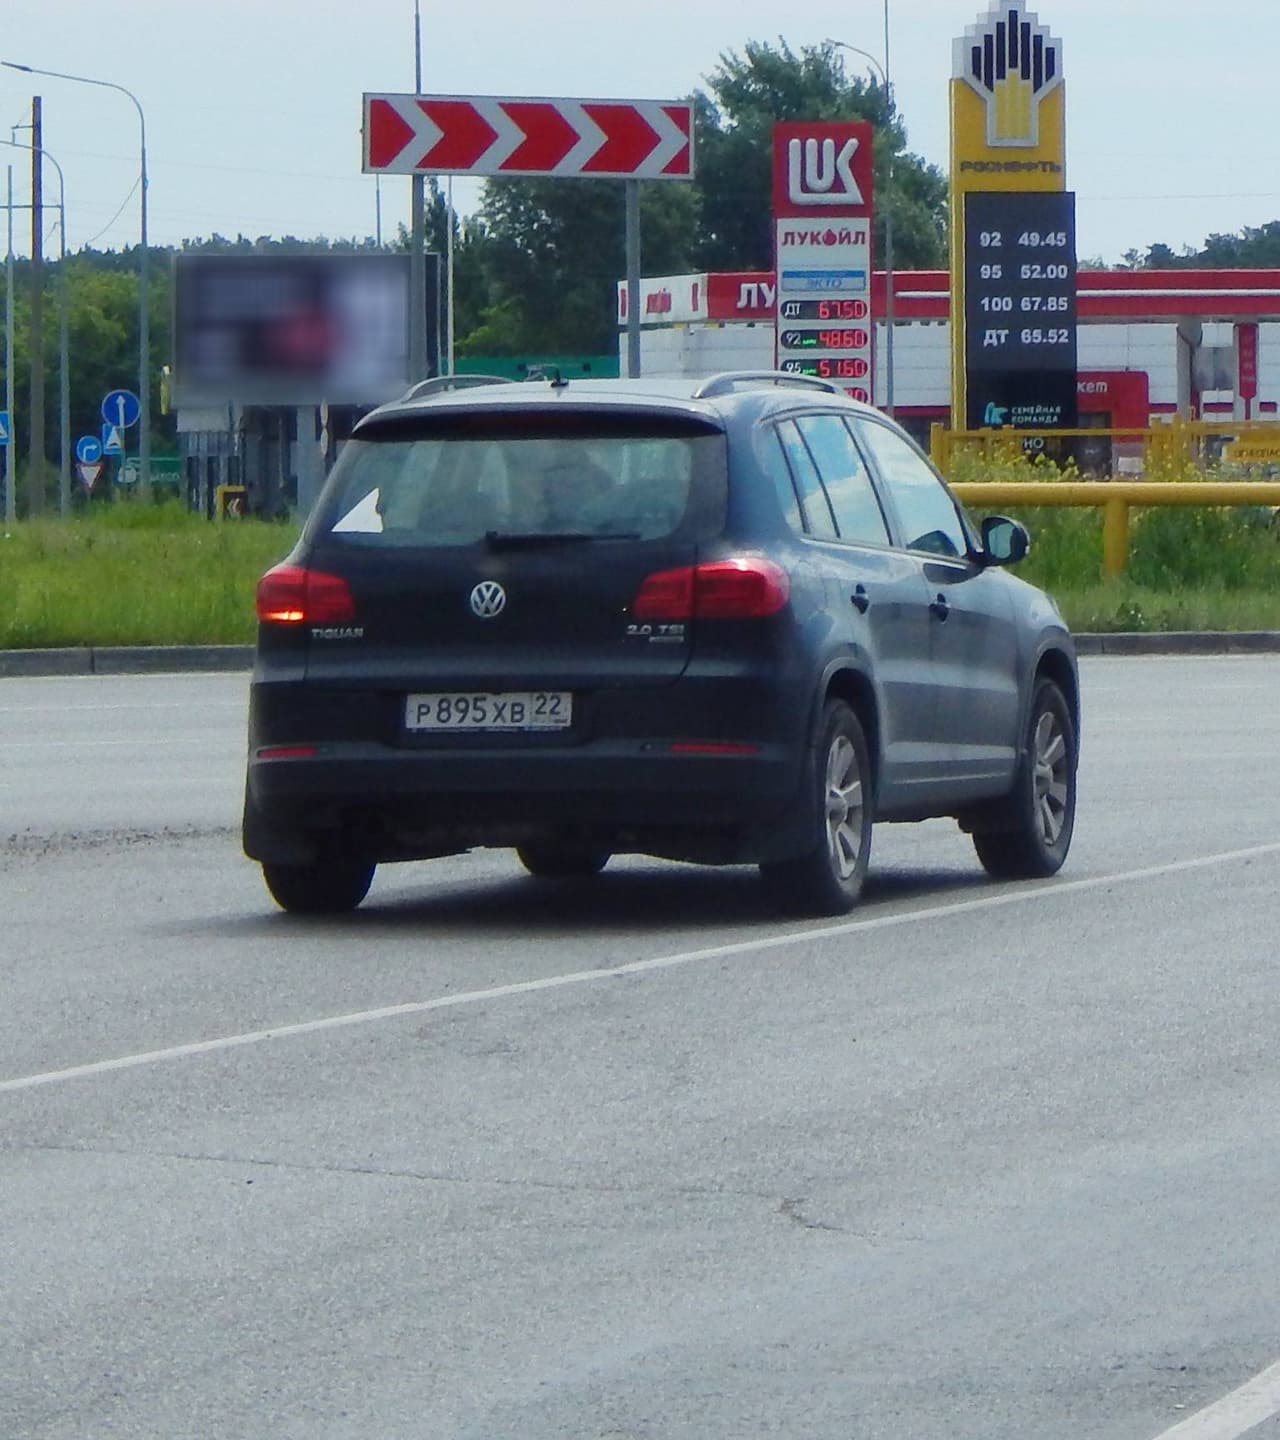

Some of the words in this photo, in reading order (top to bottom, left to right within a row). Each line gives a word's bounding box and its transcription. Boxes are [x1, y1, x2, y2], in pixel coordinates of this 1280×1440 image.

[980, 232, 1001, 247] 92
[1018, 232, 1066, 247] 49.45
[981, 297, 1012, 311] 100
[1021, 297, 1068, 311] 67.85
[1076, 381, 1108, 393] кет
[535, 694, 561, 715] 22
